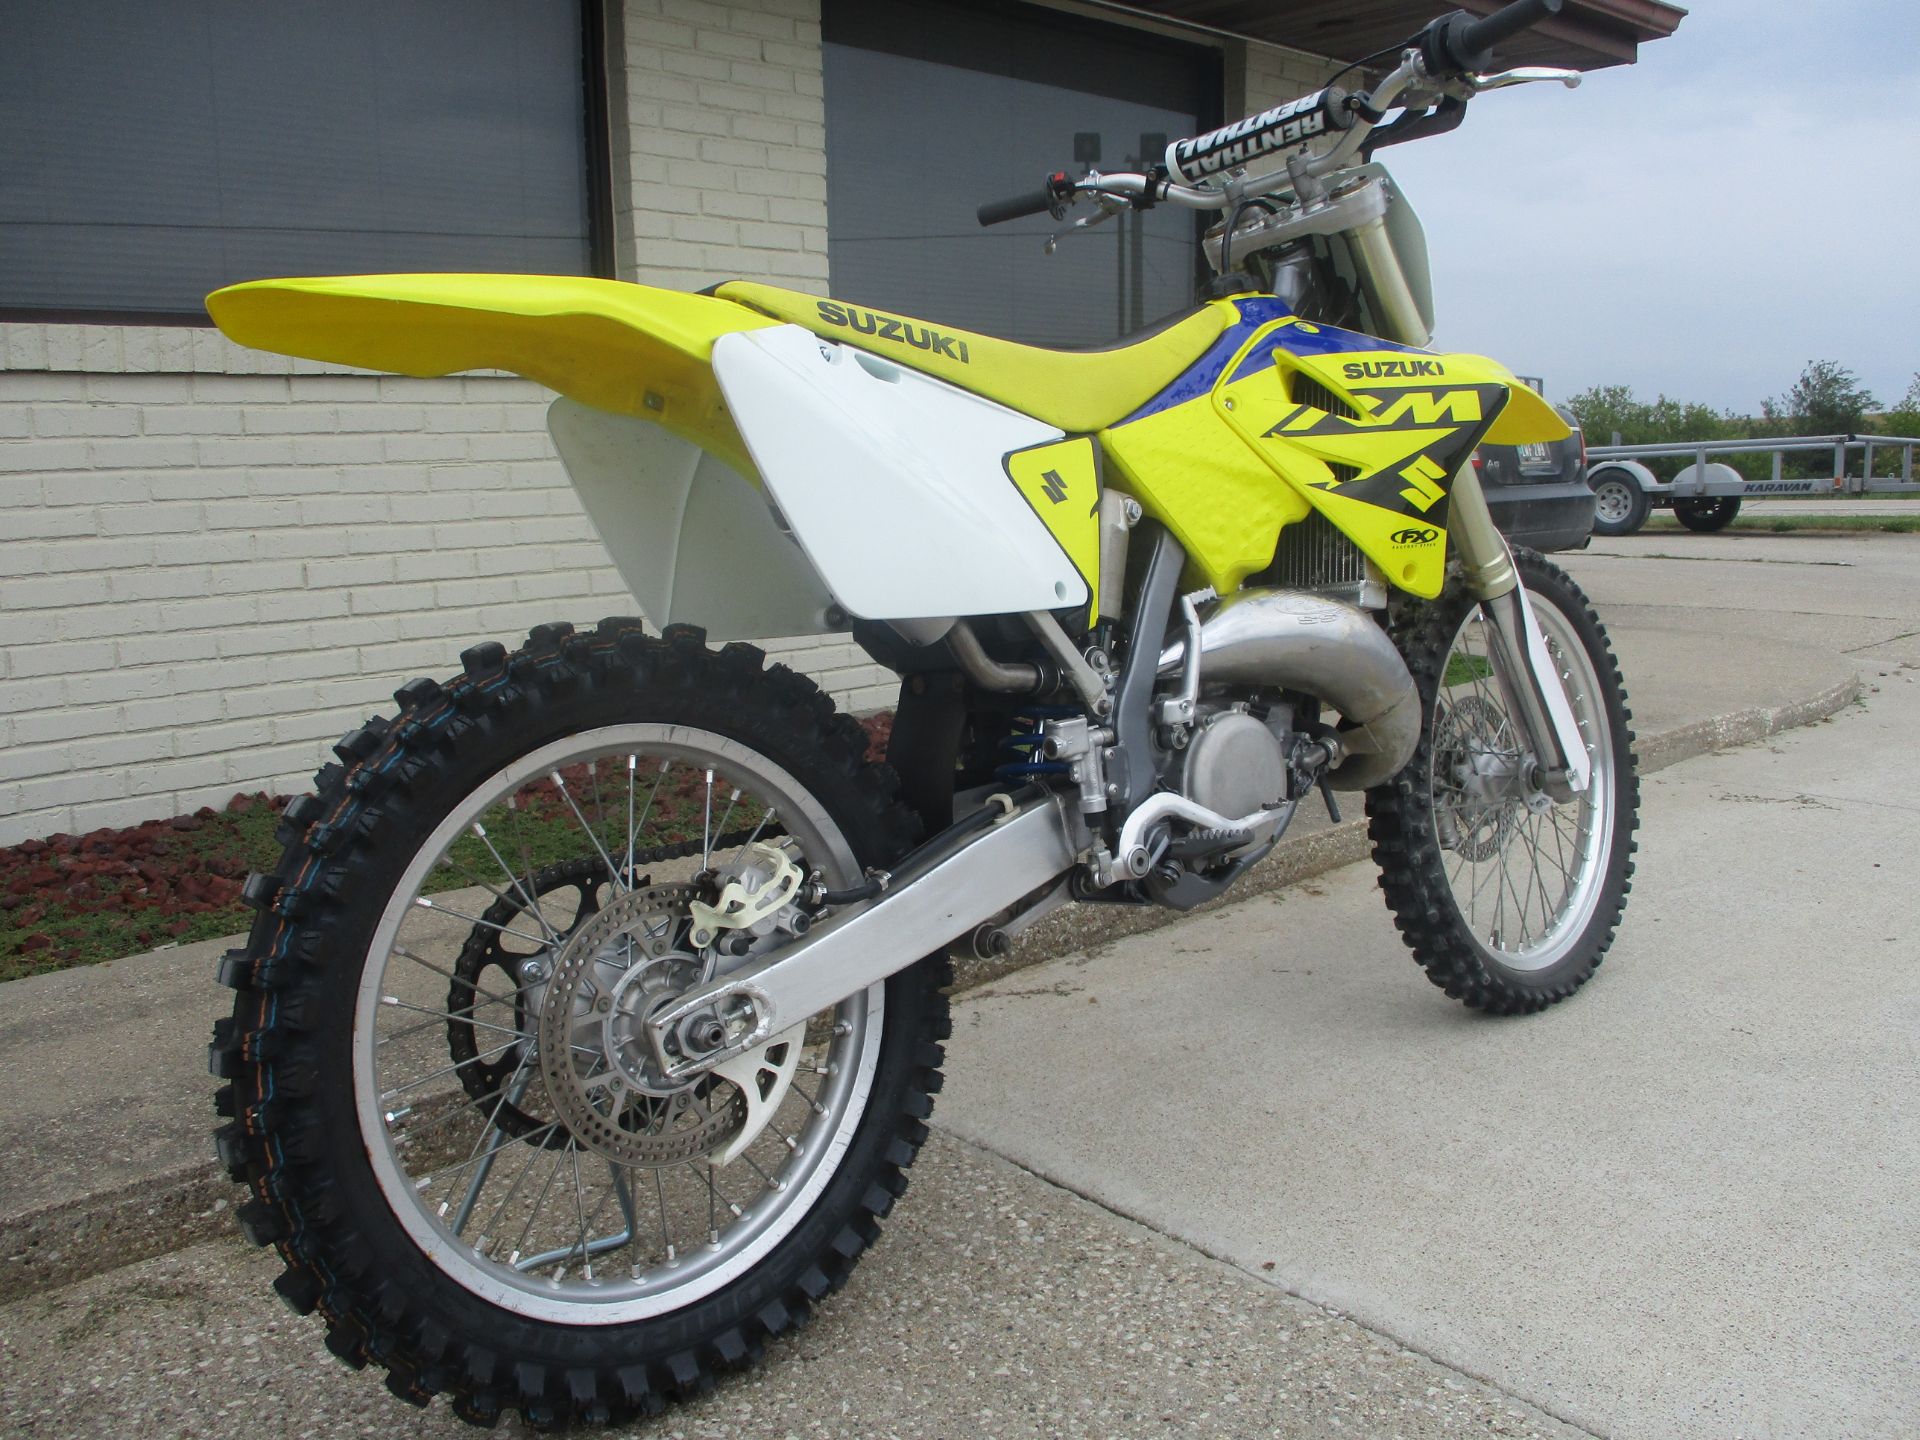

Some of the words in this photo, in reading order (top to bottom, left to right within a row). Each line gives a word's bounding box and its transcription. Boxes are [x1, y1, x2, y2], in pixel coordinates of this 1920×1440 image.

[1180, 94, 1323, 159] RENTHAL
[1181, 110, 1325, 178] RENTHAL
[816, 301, 969, 364] SUZUKI
[1343, 360, 1445, 380] SUZUKI
[1744, 483, 1812, 492] KARAVAN
